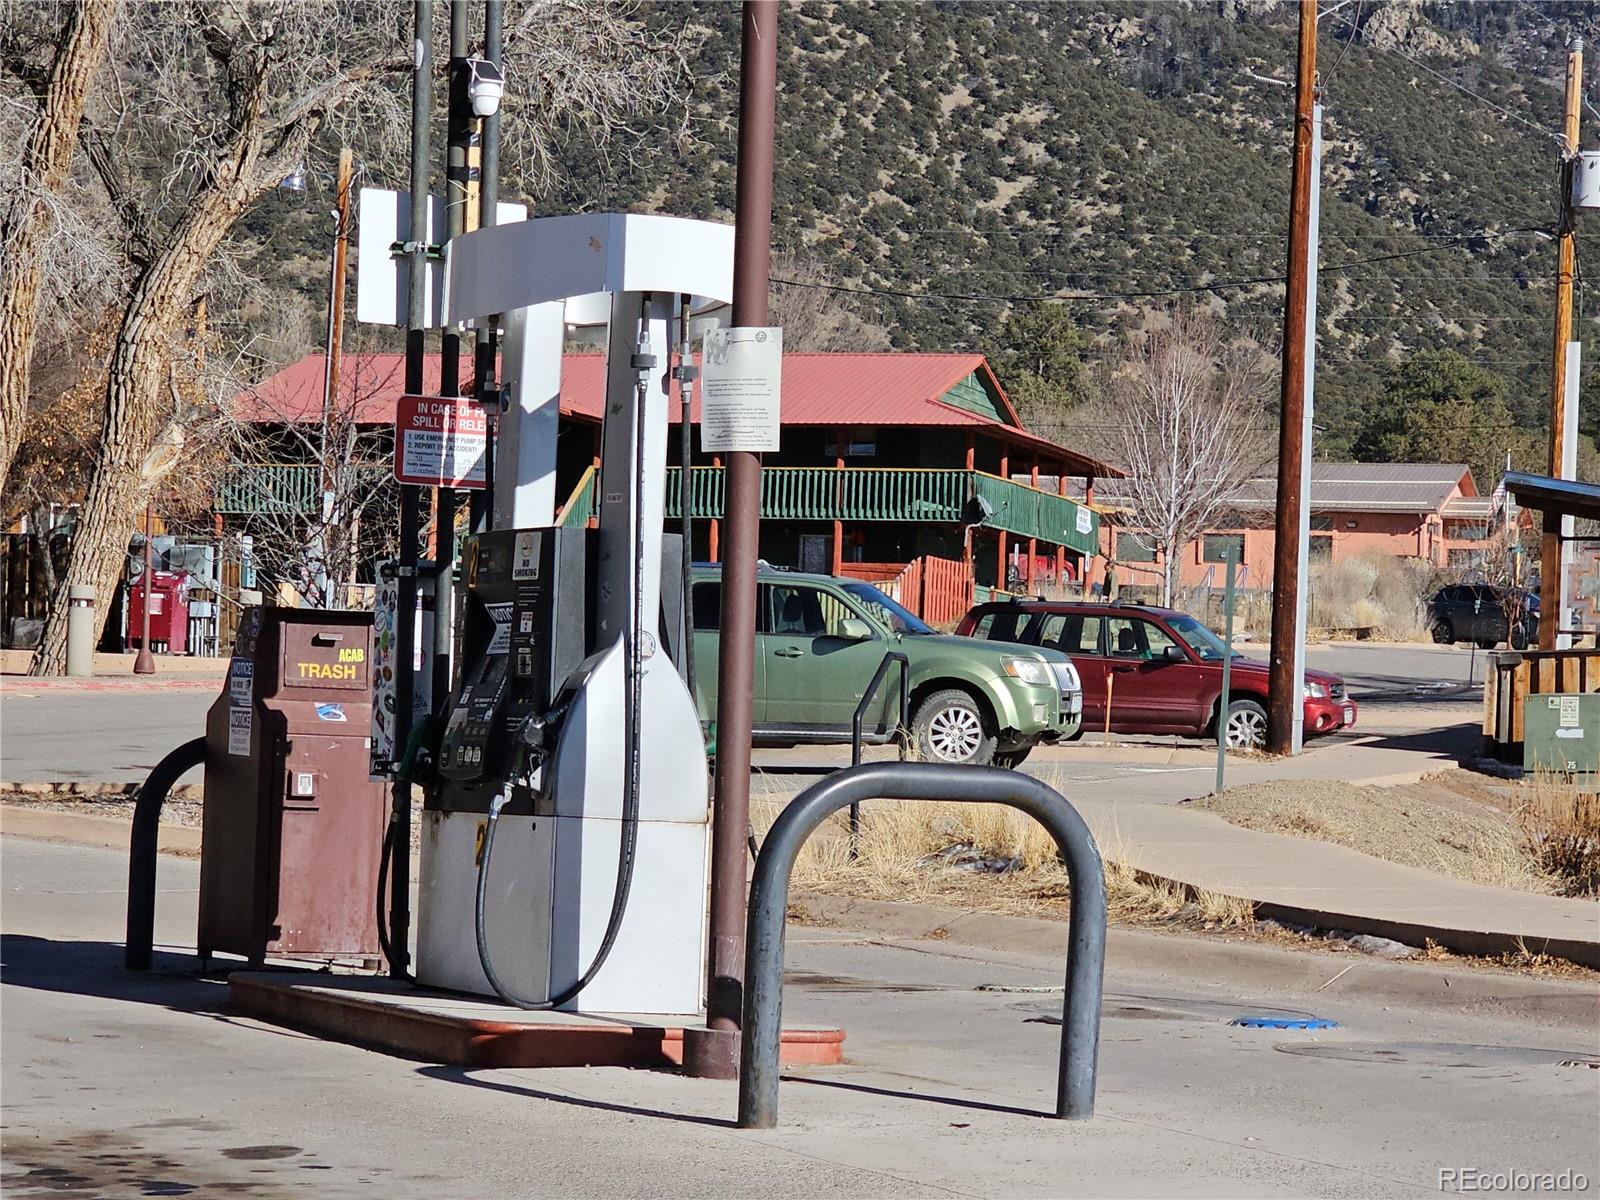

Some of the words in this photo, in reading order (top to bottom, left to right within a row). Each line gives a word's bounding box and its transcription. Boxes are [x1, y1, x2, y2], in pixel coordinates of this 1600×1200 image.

[417, 402, 428, 415] IN
[431, 403, 456, 417] CASE
[459, 405, 472, 418] OF
[412, 415, 440, 428] SPILL
[443, 418, 456, 429] OR
[415, 433, 425, 441] USE
[414, 442, 436, 450] REPORT
[522, 559, 530, 568] NO
[514, 568, 537, 577] SMOKING
[489, 607, 513, 622] NOTIC
[338, 648, 364, 662] ACAB
[232, 661, 252, 676] NOTICE
[298, 662, 356, 680] TRASH
[231, 712, 251, 727] NOTICE
[1567, 761, 1577, 769] 75
